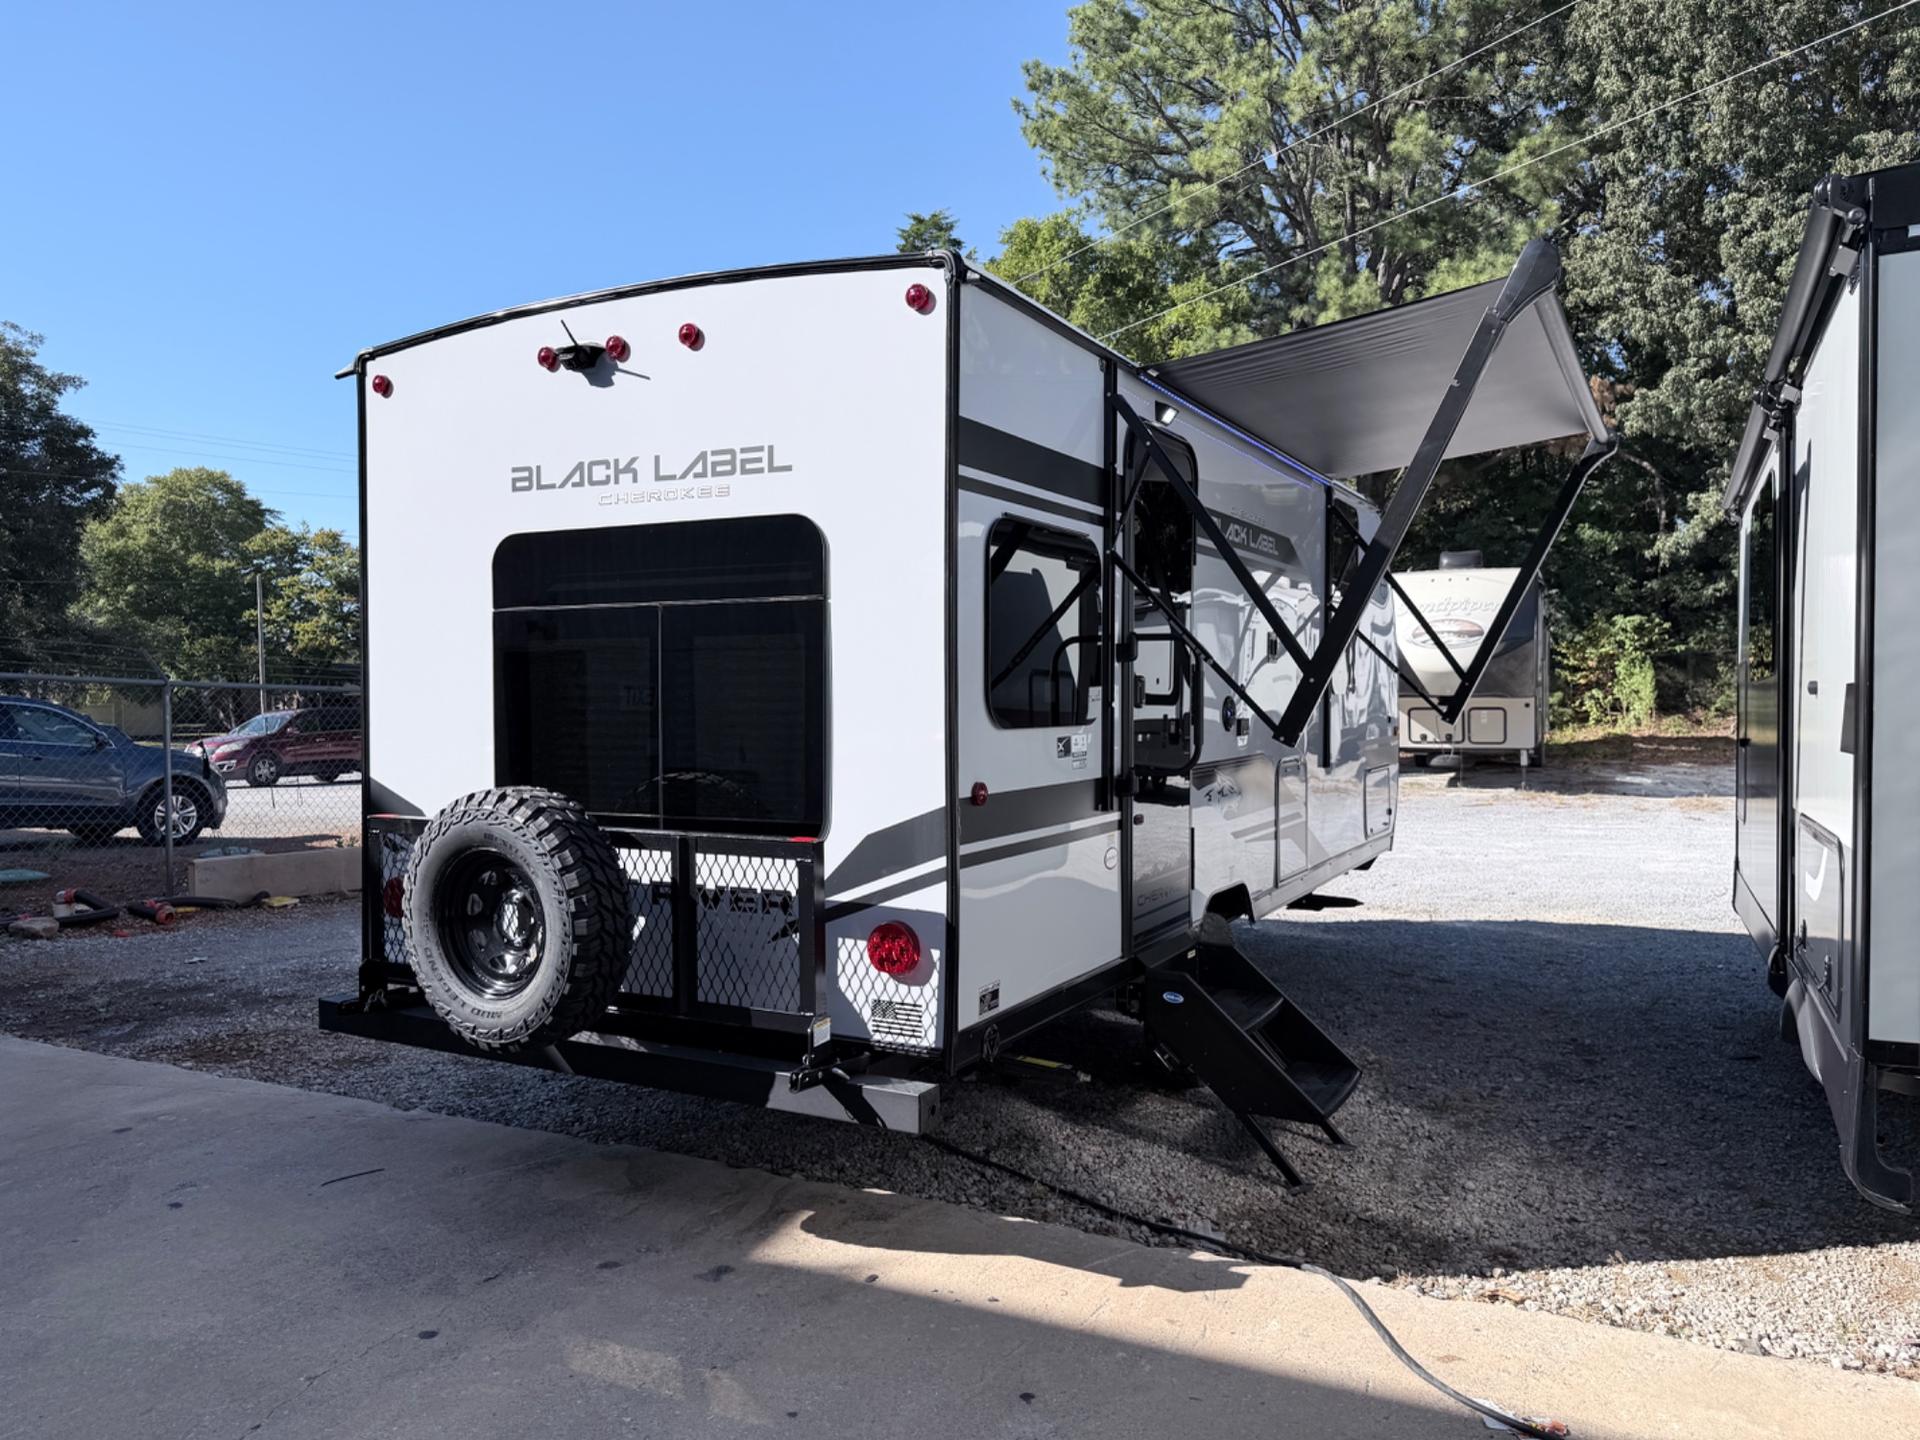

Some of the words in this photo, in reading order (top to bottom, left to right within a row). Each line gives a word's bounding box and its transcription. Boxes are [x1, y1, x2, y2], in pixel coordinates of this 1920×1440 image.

[511, 456, 640, 492] BLACK
[654, 444, 793, 482] LABEL
[598, 484, 731, 506] CHEROKEE
[1249, 529, 1279, 555] LABEL
[1396, 597, 1501, 617] Sndpiper
